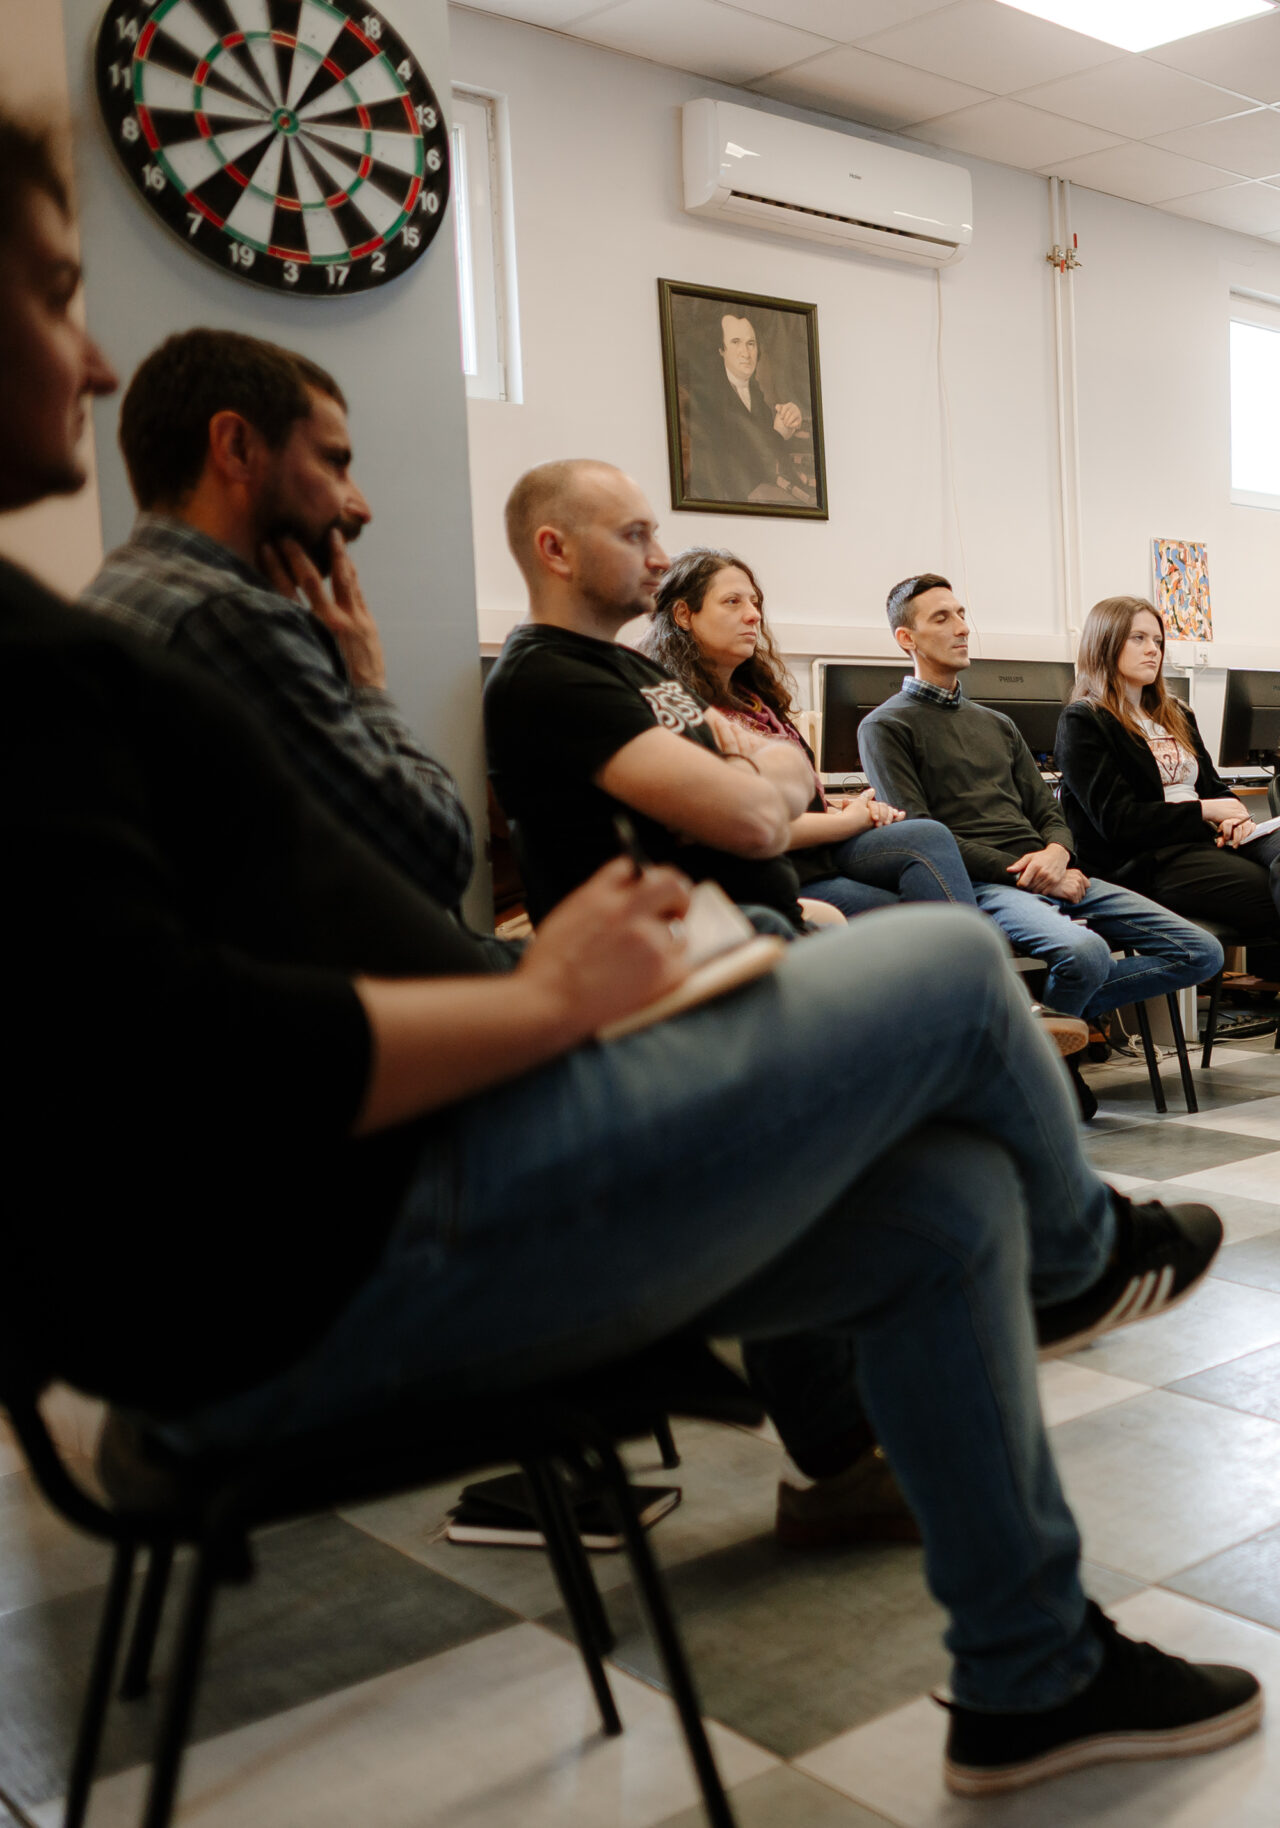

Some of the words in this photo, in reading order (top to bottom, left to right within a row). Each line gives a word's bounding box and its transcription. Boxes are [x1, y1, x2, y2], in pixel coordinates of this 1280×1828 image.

[116, 16, 139, 42] 14
[362, 16, 381, 39] 18
[109, 65, 131, 90] 11
[397, 59, 412, 81] 4
[416, 106, 436, 128] 13
[122, 116, 139, 142] 8
[426, 150, 440, 171] 6
[143, 165, 166, 191] 16
[419, 191, 438, 212] 10
[187, 212, 204, 235] 7
[402, 227, 420, 248] 15
[228, 242, 255, 267] 19
[371, 253, 386, 272] 2
[283, 261, 299, 283] 3
[326, 264, 349, 286] 17
